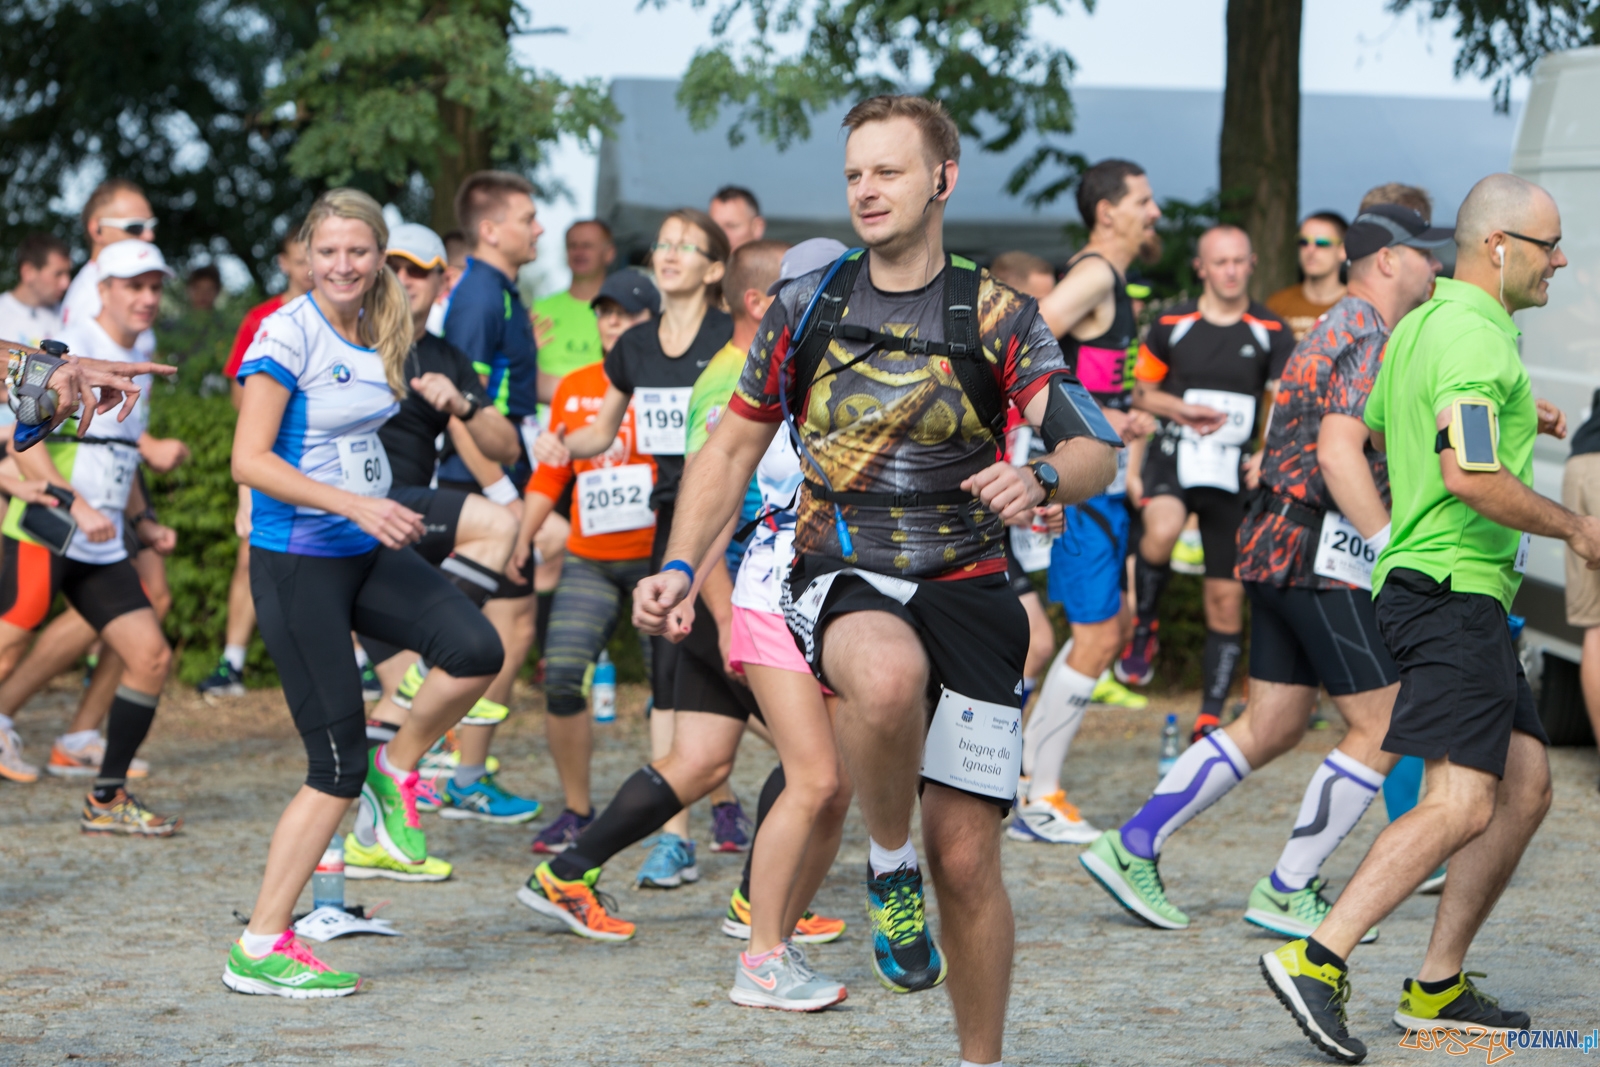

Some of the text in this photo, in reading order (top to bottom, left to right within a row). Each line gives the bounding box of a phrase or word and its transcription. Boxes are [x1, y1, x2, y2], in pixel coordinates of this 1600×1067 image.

[364, 457, 381, 482] 60
[586, 485, 643, 511] 2052
[958, 737, 1011, 760] biegnę dla
[962, 756, 1002, 776] Ignasia
